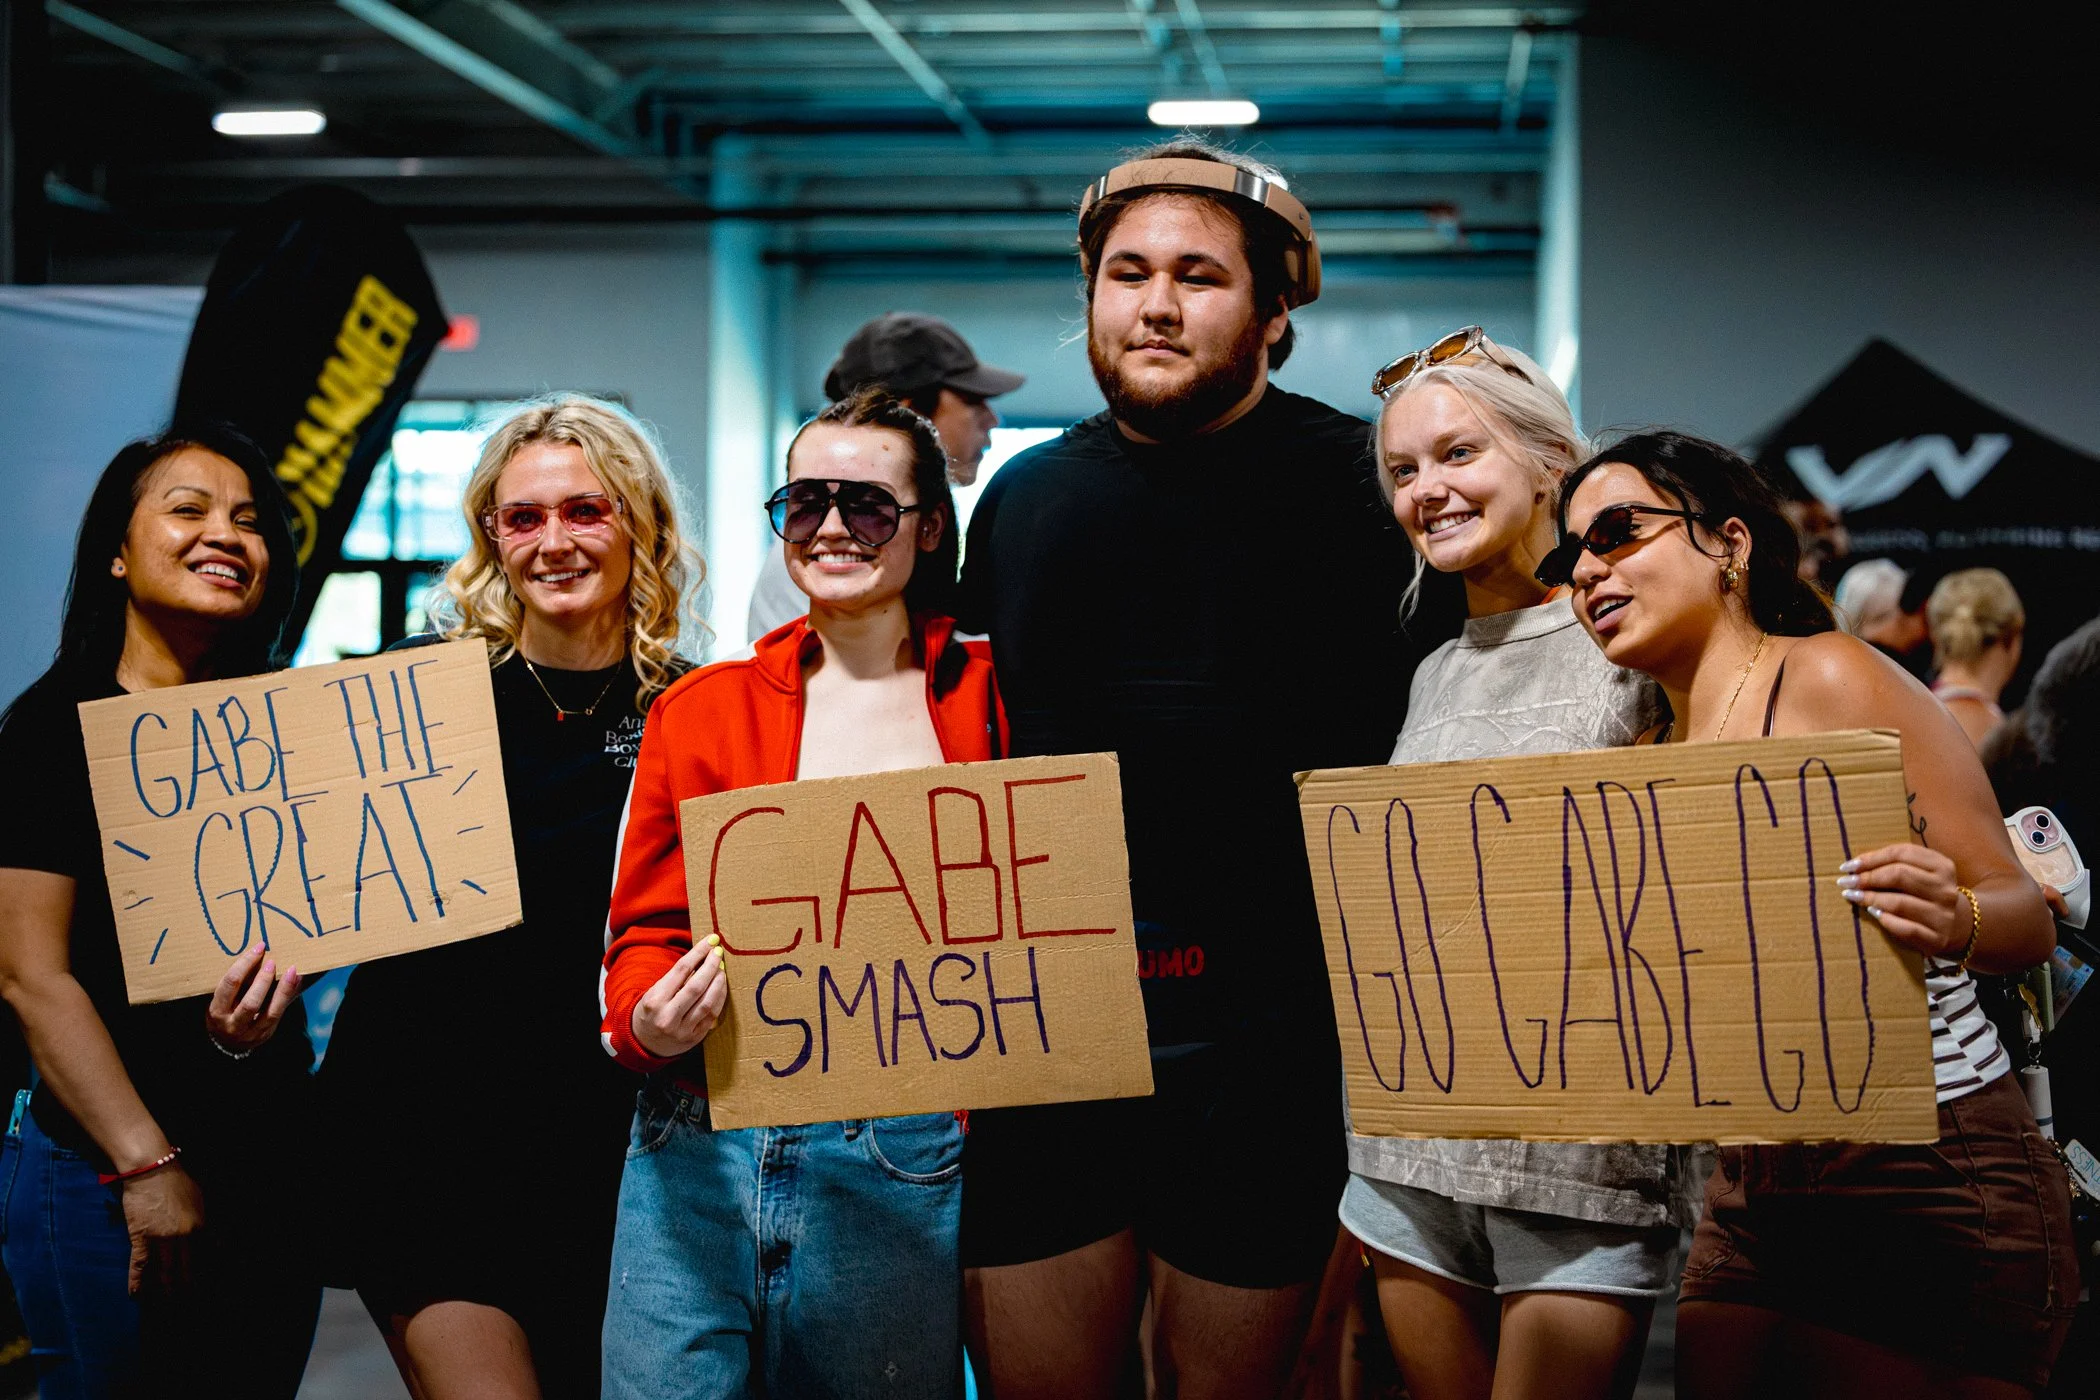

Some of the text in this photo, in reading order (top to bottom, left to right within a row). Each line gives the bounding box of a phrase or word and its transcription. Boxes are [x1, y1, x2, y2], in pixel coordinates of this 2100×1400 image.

[130, 659, 454, 819] GABE THE
[193, 773, 445, 957] GREAT
[708, 774, 1117, 956] GABE
[1328, 757, 1875, 1115] GO GABE GO
[756, 946, 1050, 1078] SMASH
